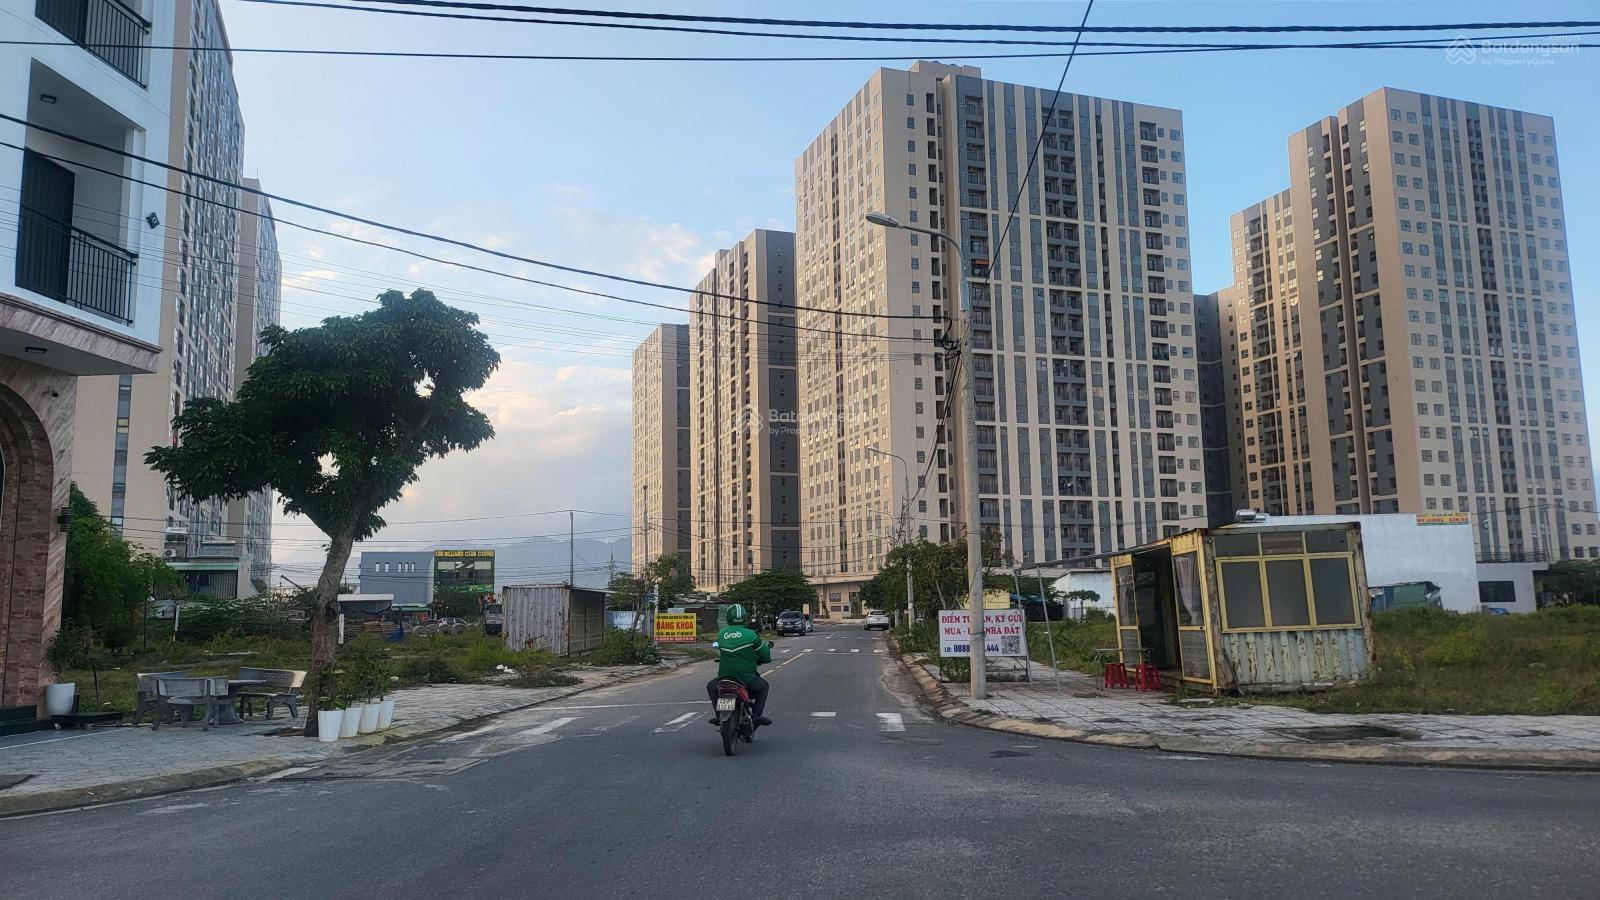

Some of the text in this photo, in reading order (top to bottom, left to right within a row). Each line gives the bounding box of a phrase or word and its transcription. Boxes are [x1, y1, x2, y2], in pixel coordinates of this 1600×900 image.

[942, 612, 960, 623] ĐIỂM
[995, 613, 1006, 622] KÝ
[724, 631, 742, 639] Grab
[944, 627, 961, 635] MUA
